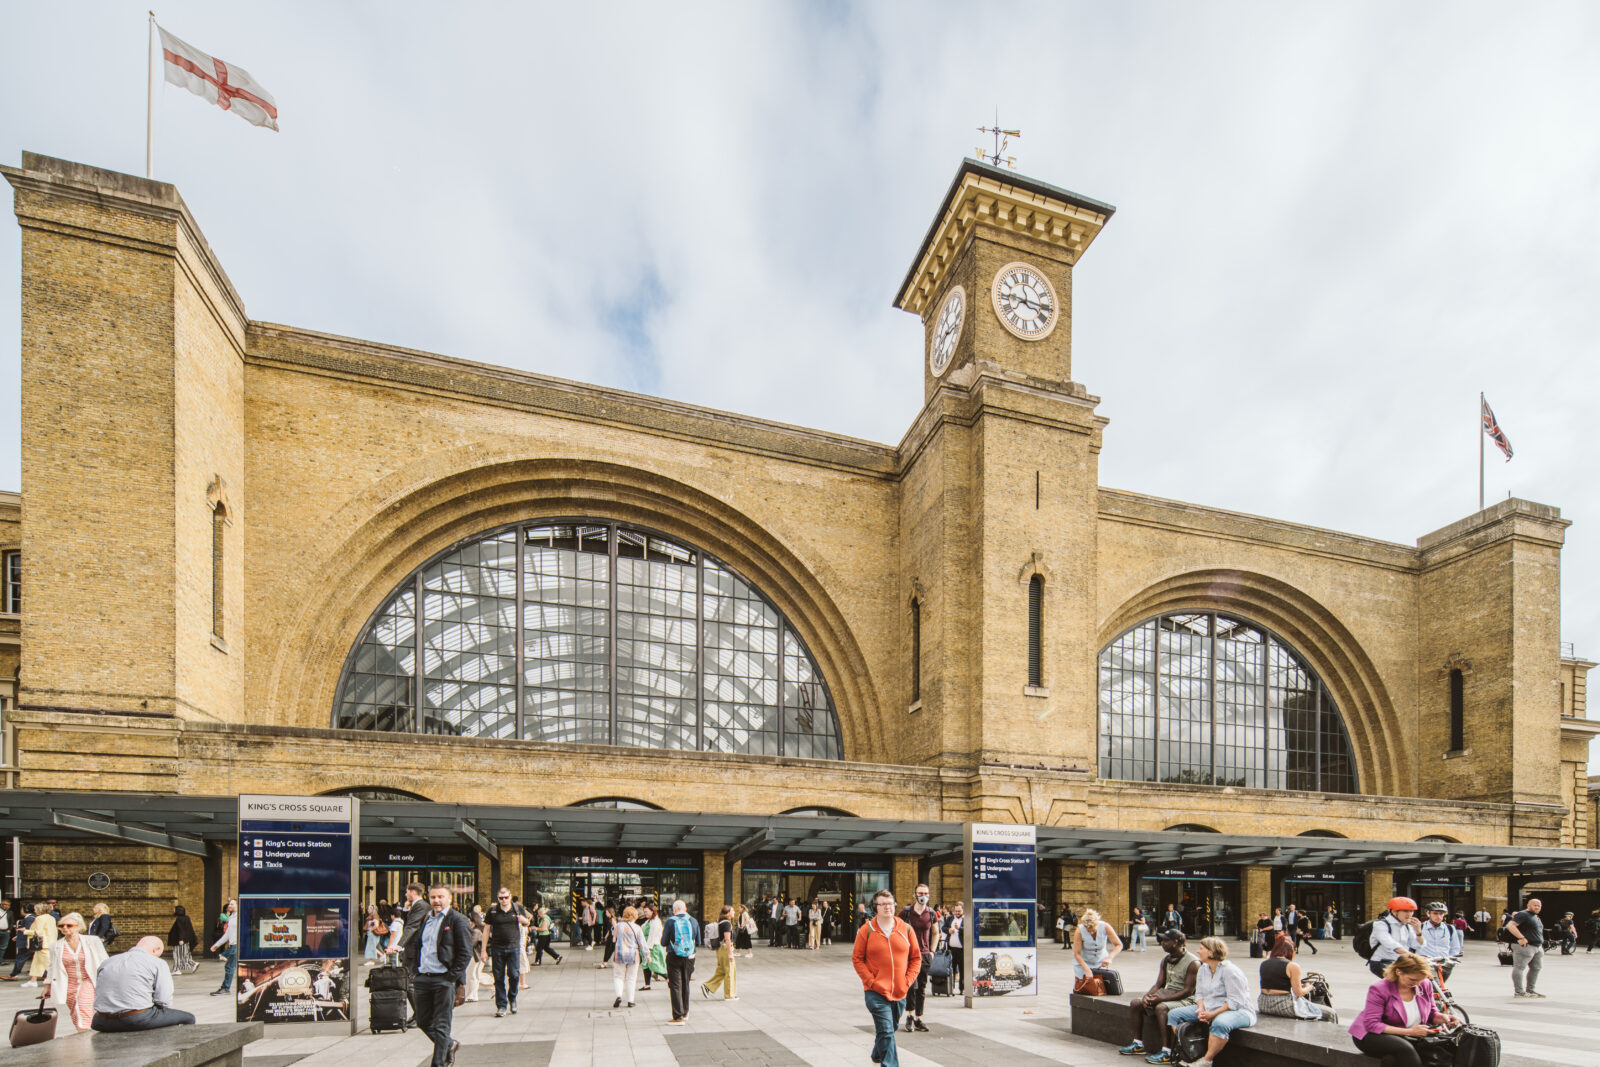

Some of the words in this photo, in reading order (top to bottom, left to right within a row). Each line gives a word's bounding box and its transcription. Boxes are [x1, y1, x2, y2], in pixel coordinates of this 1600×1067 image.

[975, 147, 986, 160] W
[1008, 156, 1017, 169] E
[247, 803, 277, 811] KING'S
[278, 804, 307, 812] CROSS
[309, 804, 343, 813] SQUARE
[265, 840, 286, 848] King's
[401, 854, 414, 862] only
